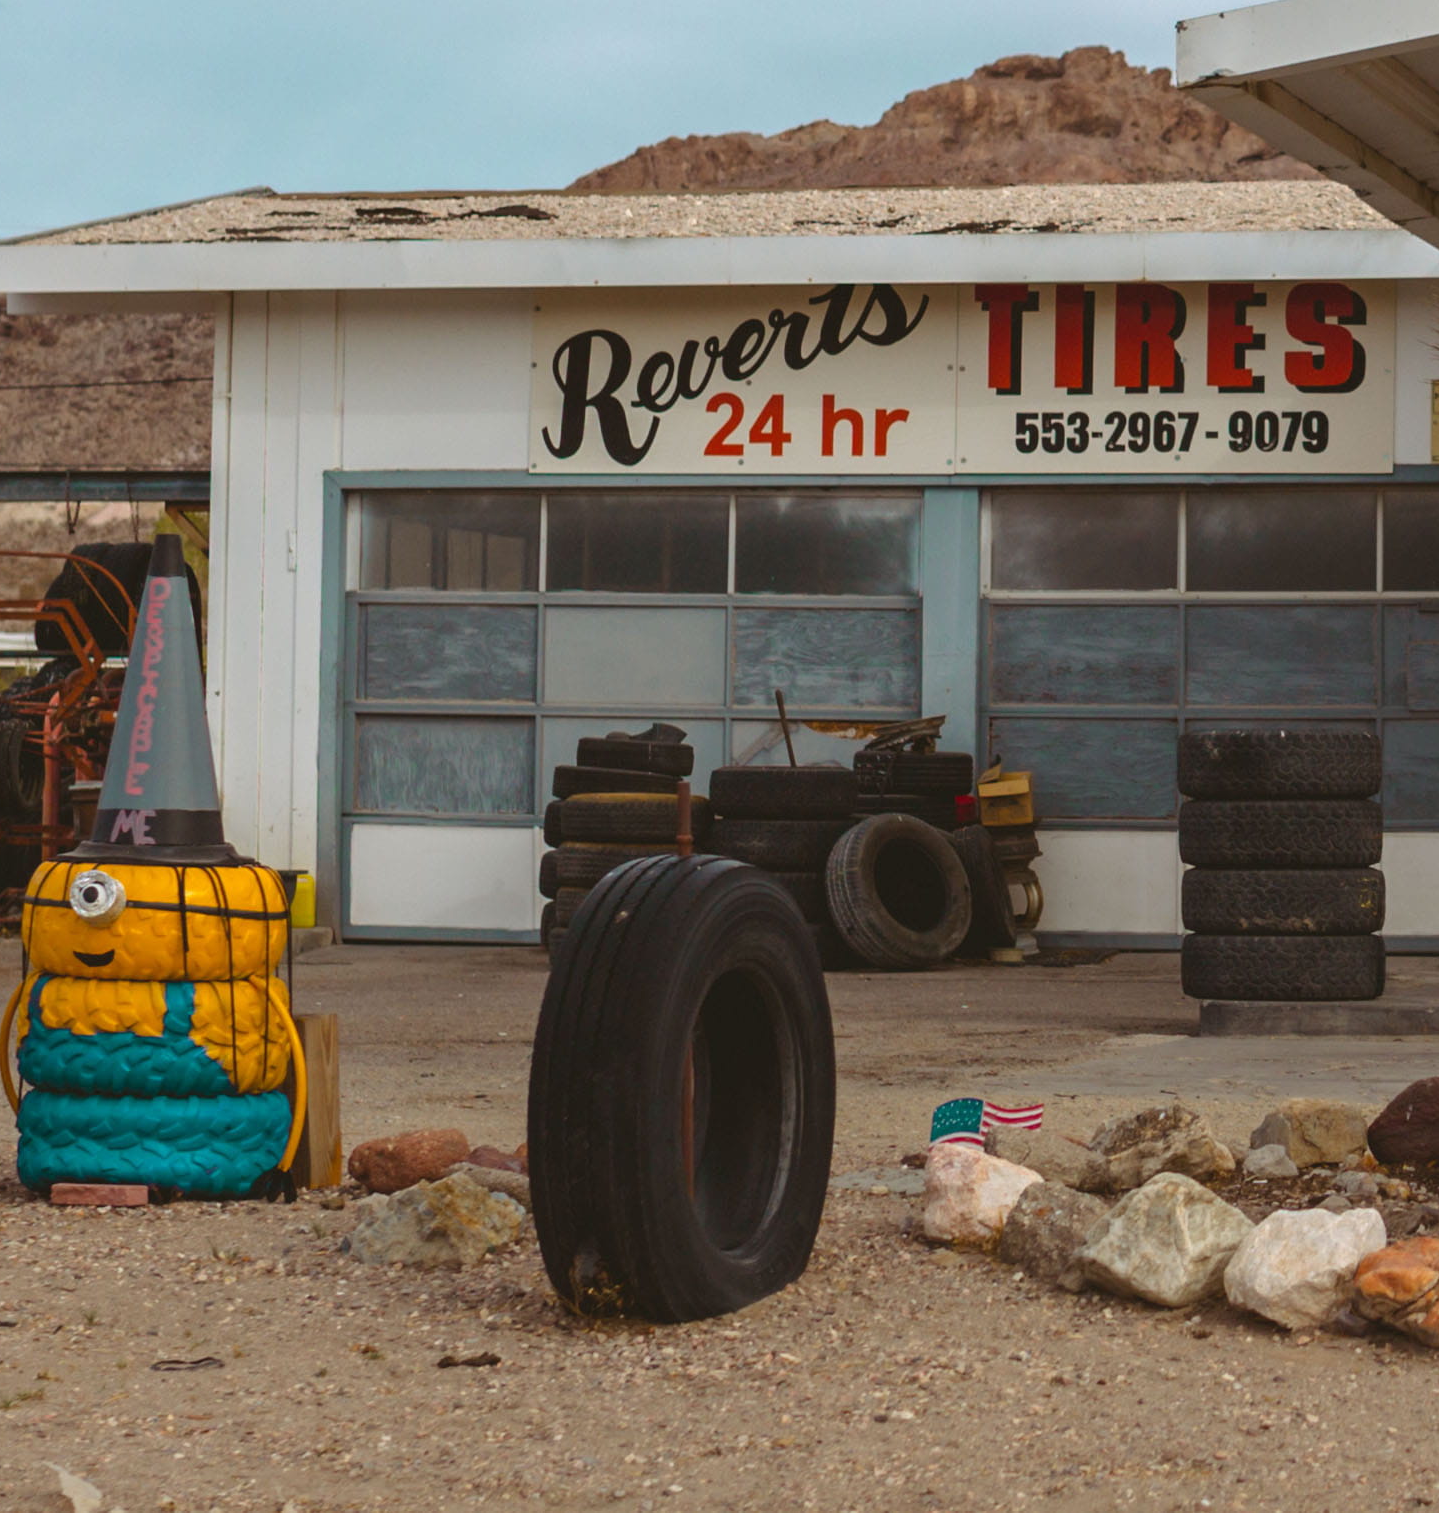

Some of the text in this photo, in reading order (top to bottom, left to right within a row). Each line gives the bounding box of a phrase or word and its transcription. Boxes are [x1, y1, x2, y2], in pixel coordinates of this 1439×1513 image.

[542, 284, 930, 466] Reverts
[974, 282, 1368, 396] TIRES
[703, 392, 910, 457] 24 hr
[110, 809, 158, 846] ME
